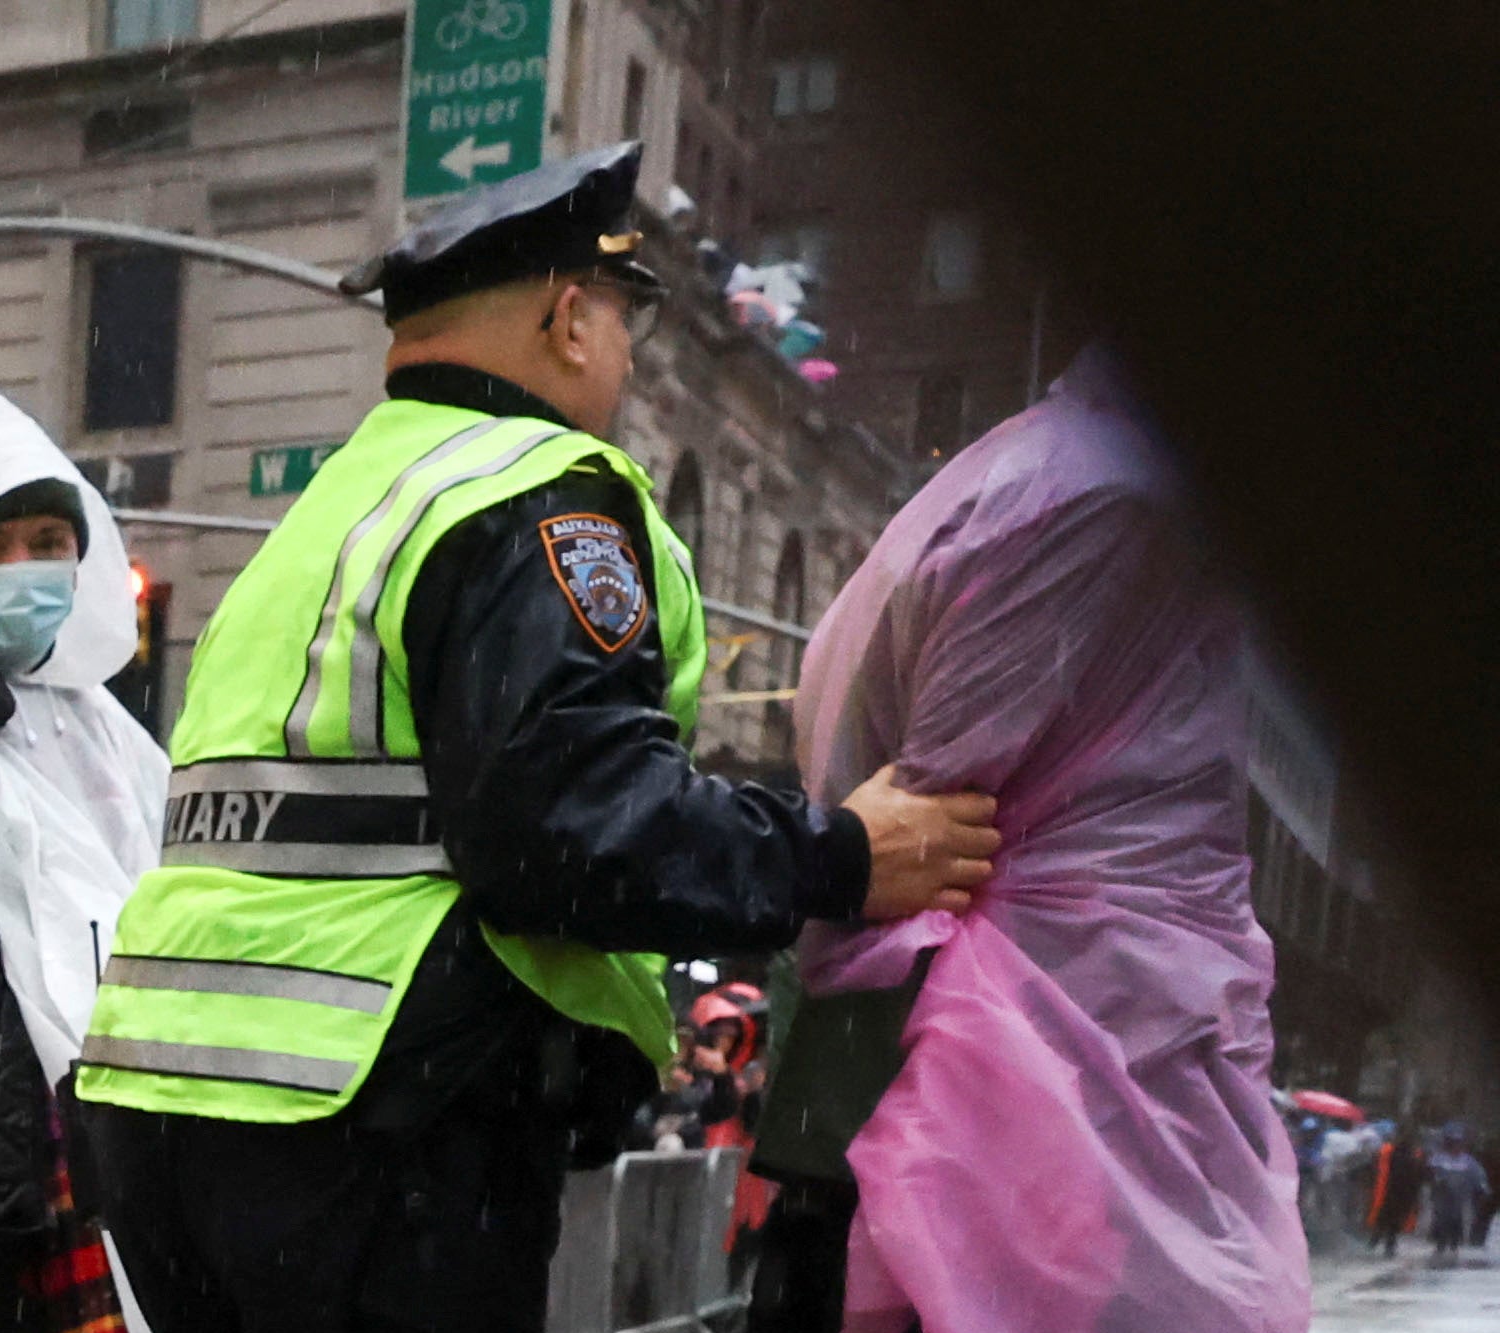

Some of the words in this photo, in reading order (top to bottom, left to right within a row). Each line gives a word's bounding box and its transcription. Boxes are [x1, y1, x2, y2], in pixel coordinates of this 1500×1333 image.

[410, 57, 547, 98] Hudson
[429, 98, 521, 132] River
[259, 453, 289, 490] W
